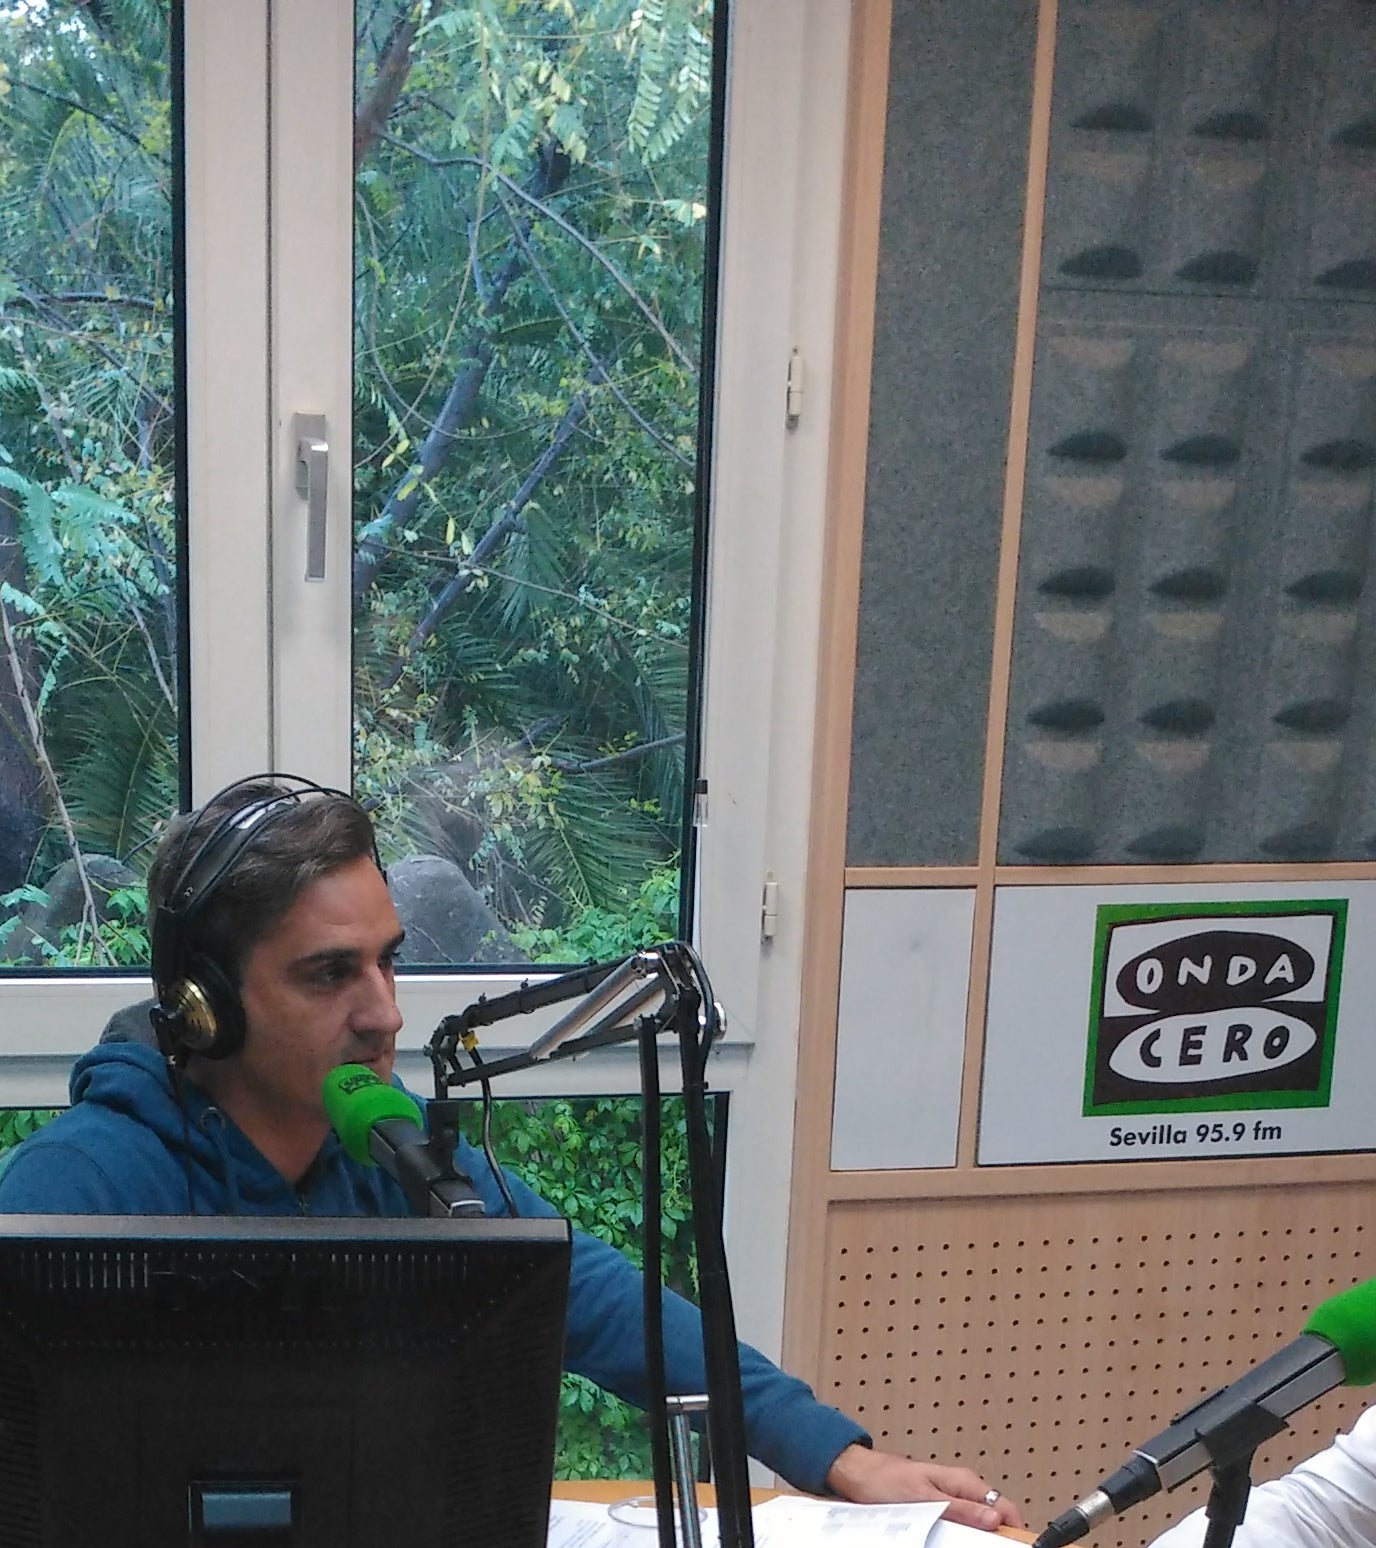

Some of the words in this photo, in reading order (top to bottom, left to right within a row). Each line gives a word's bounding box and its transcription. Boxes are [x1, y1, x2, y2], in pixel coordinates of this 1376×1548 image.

[1135, 953, 1295, 994] ONDA
[1139, 1023, 1291, 1068] CERO
[1109, 1124, 1187, 1147] Sevilla
[1195, 1122, 1246, 1143] 95.9
[1252, 1120, 1282, 1141] fm
